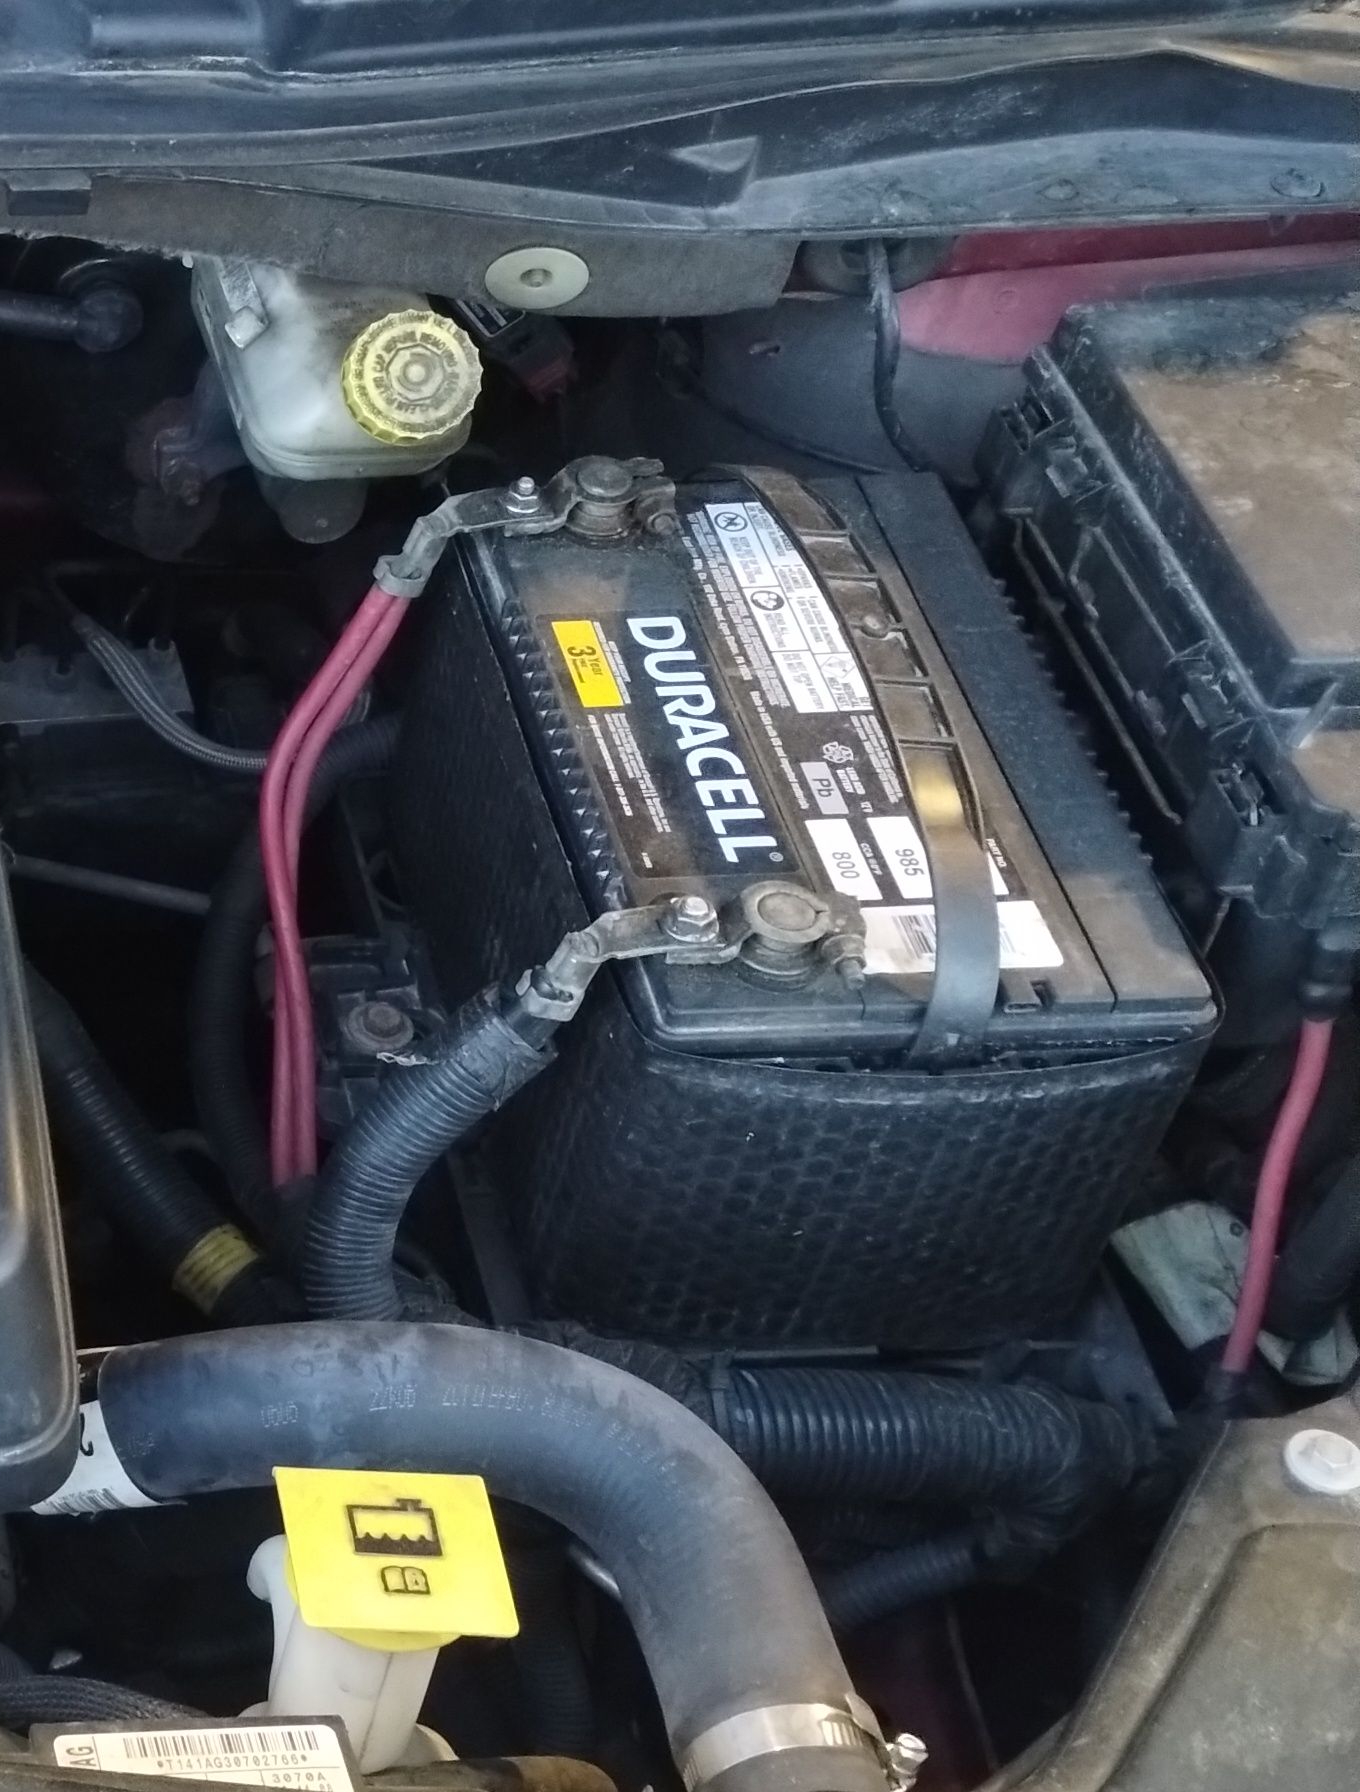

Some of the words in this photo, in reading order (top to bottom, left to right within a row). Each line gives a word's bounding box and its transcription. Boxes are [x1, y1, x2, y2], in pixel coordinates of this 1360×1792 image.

[374, 353, 386, 372] CAP
[567, 645, 596, 657] 3
[588, 658, 602, 676] Year
[627, 616, 777, 862] DURACELL
[812, 778, 834, 797] Pb
[986, 838, 1000, 858] PART
[832, 852, 860, 878] 800
[895, 848, 925, 876] 985
[66, 1746, 96, 1766] AG
[272, 1772, 326, 1783] 3070A
